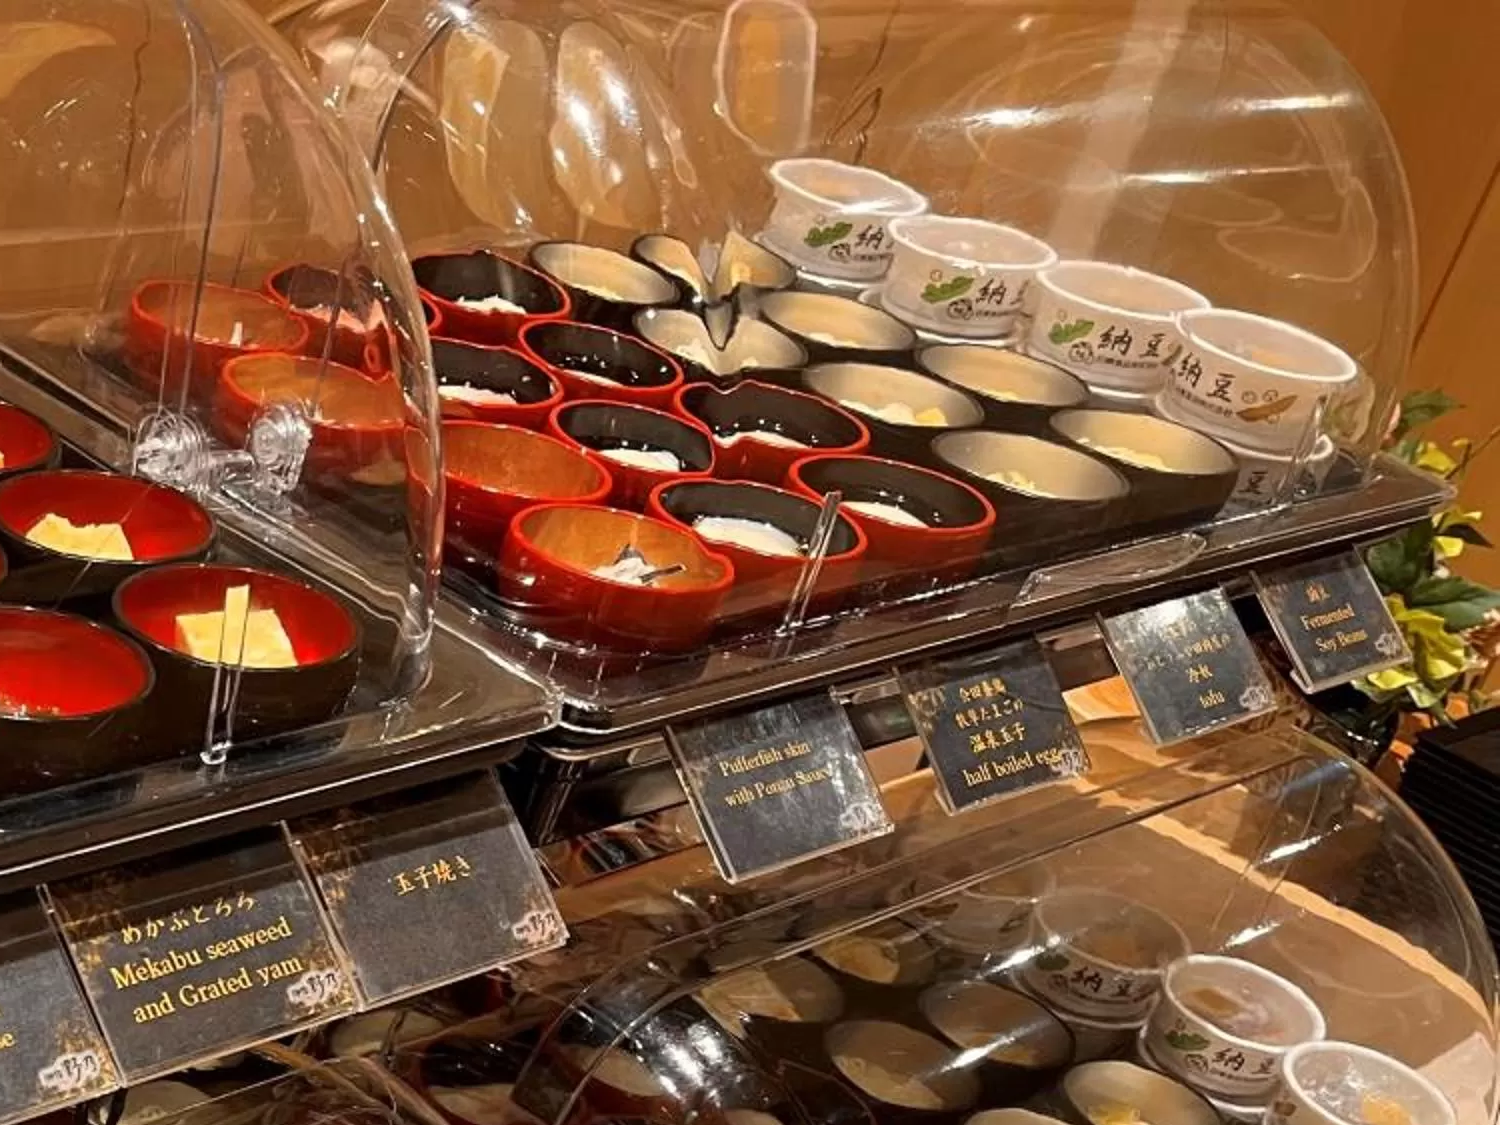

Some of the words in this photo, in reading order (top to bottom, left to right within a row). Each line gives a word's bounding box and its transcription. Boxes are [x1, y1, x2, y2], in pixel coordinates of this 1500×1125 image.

[854, 224, 895, 250] 納
[1098, 325, 1166, 359] 納豆
[1178, 352, 1238, 402] 納豆
[784, 740, 812, 760] skin
[962, 762, 993, 788] half
[991, 751, 1034, 777] boiled
[724, 788, 755, 807] with
[394, 855, 471, 896] 玉子焼き
[109, 948, 203, 990] Mekabu
[205, 915, 293, 961] seaweed
[132, 992, 177, 1024] and
[178, 967, 253, 1008] Grated
[256, 956, 304, 987] yam
